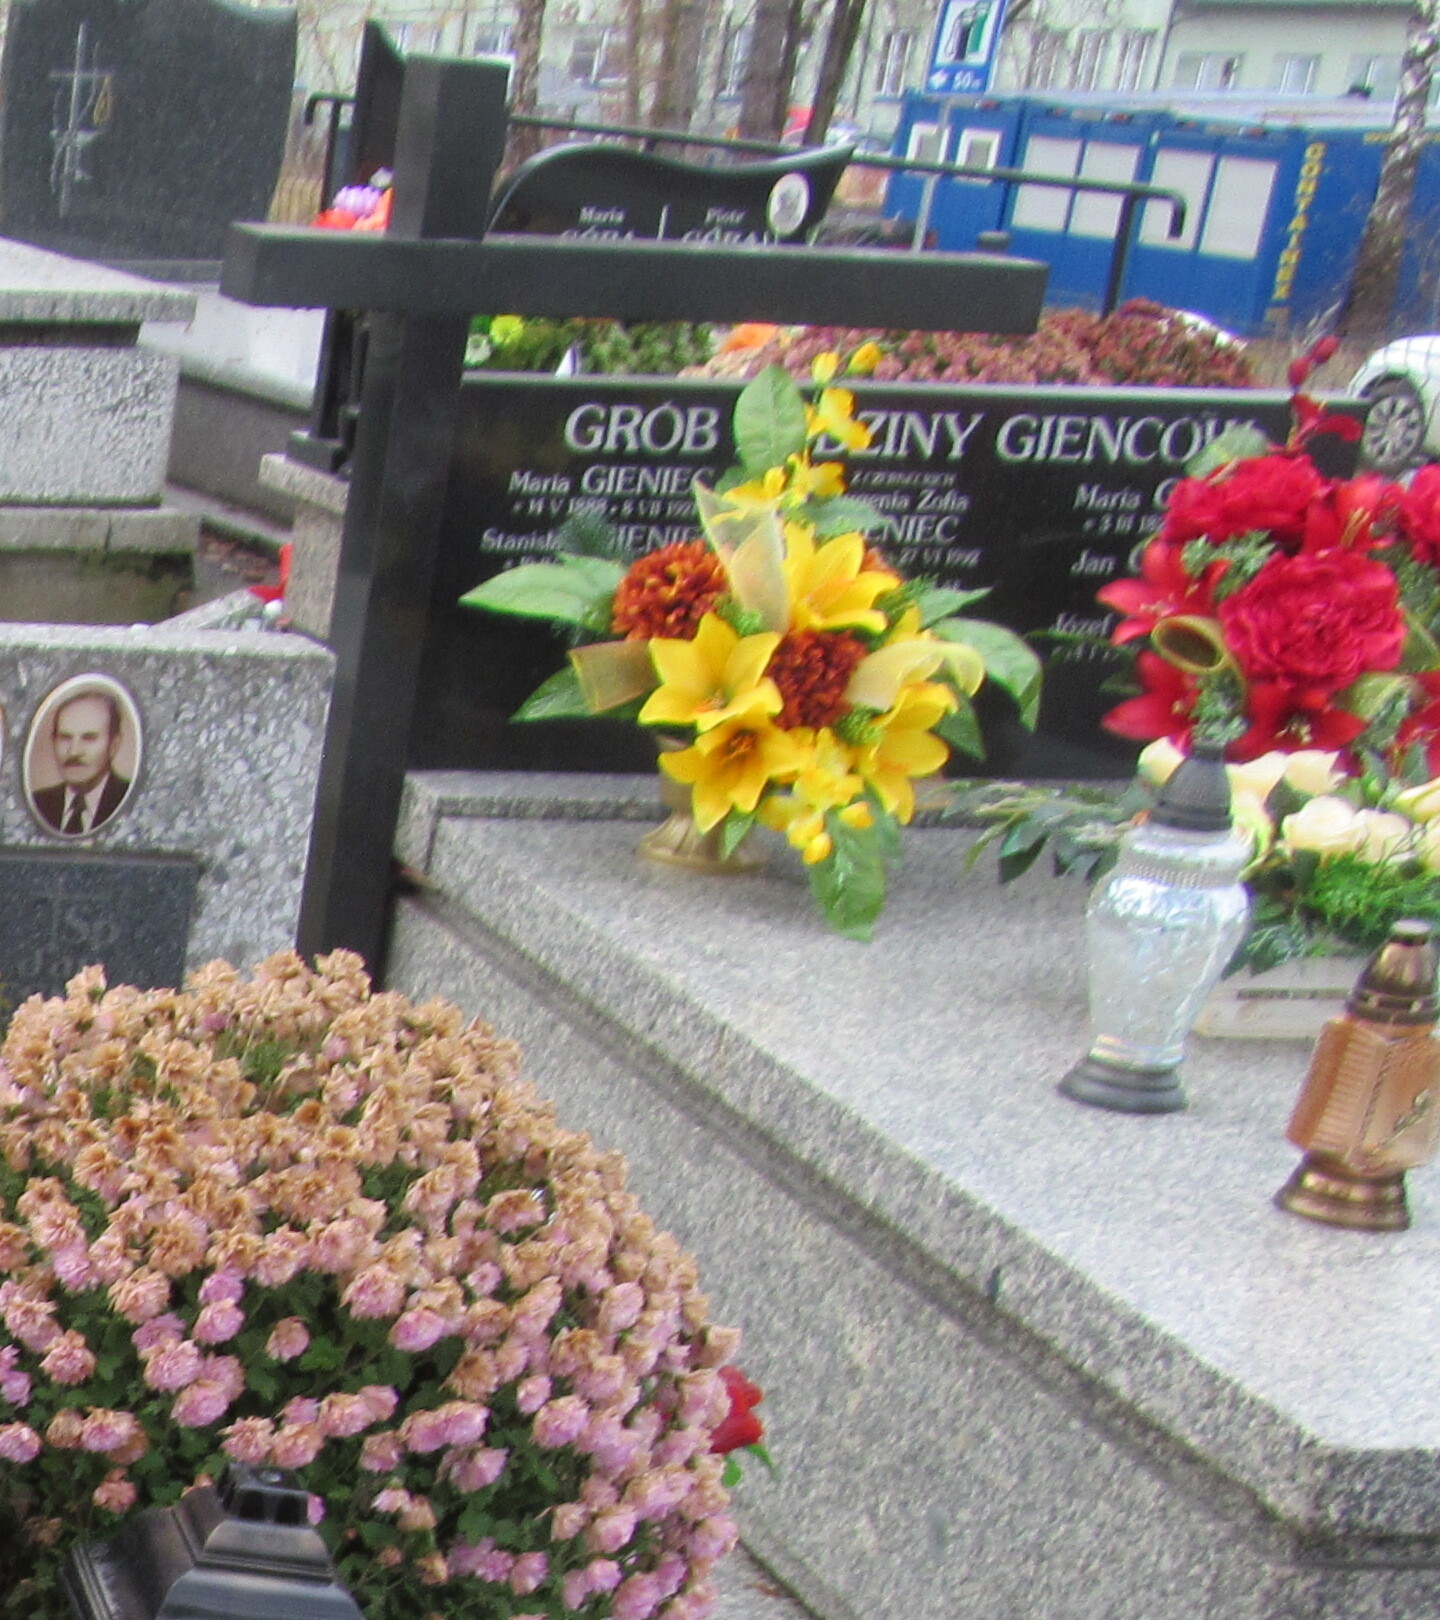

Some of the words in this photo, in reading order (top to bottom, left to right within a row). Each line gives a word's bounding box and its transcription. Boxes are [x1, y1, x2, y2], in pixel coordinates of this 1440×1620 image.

[565, 401, 720, 453] GRÓB
[508, 470, 571, 494] Maria
[1073, 482, 1142, 510] Maria
[1070, 549, 1117, 575] Jan
